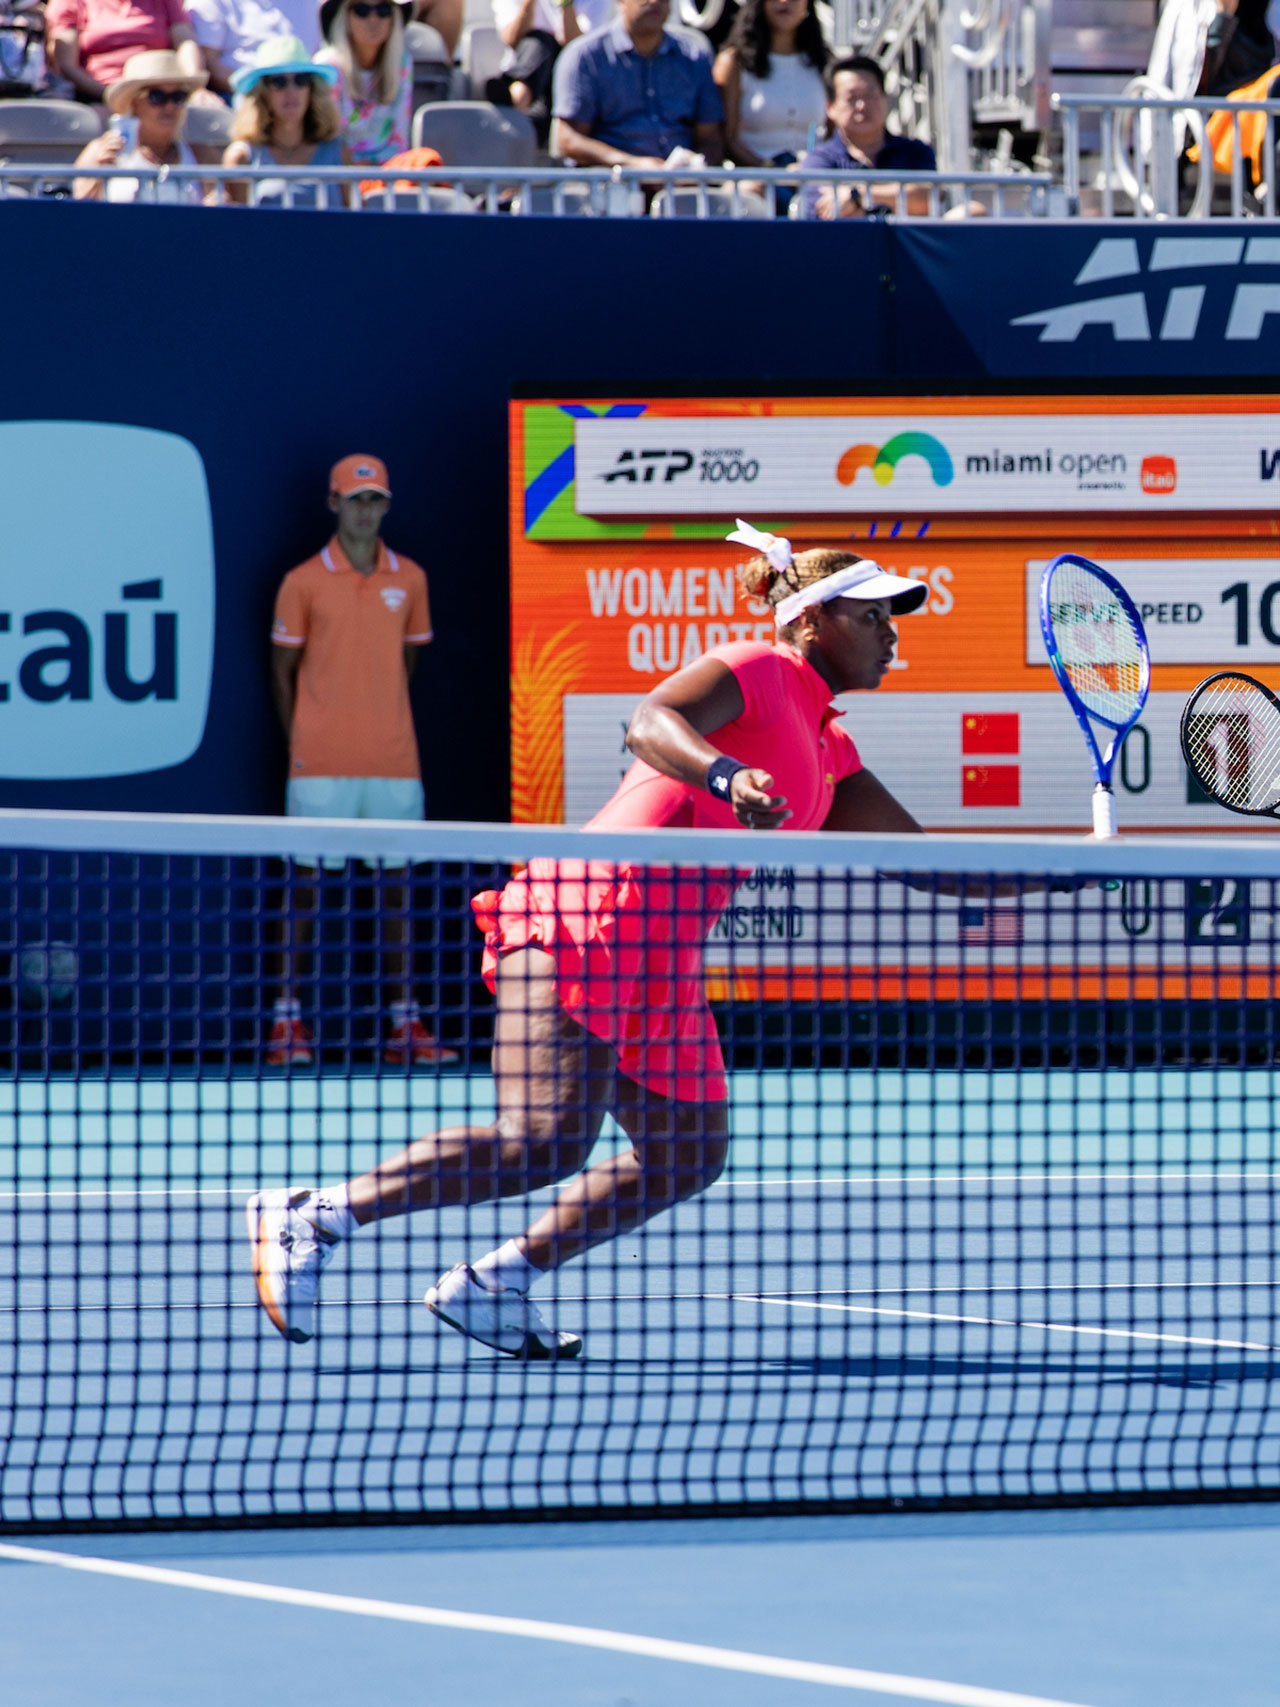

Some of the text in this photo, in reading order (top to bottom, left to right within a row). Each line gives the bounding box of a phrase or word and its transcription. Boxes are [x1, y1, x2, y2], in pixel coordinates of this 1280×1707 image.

[597, 449, 760, 482] ATP 1000
[966, 449, 1127, 478] miami open
[1137, 602, 1204, 624] PEED
[0, 577, 179, 704] aú
